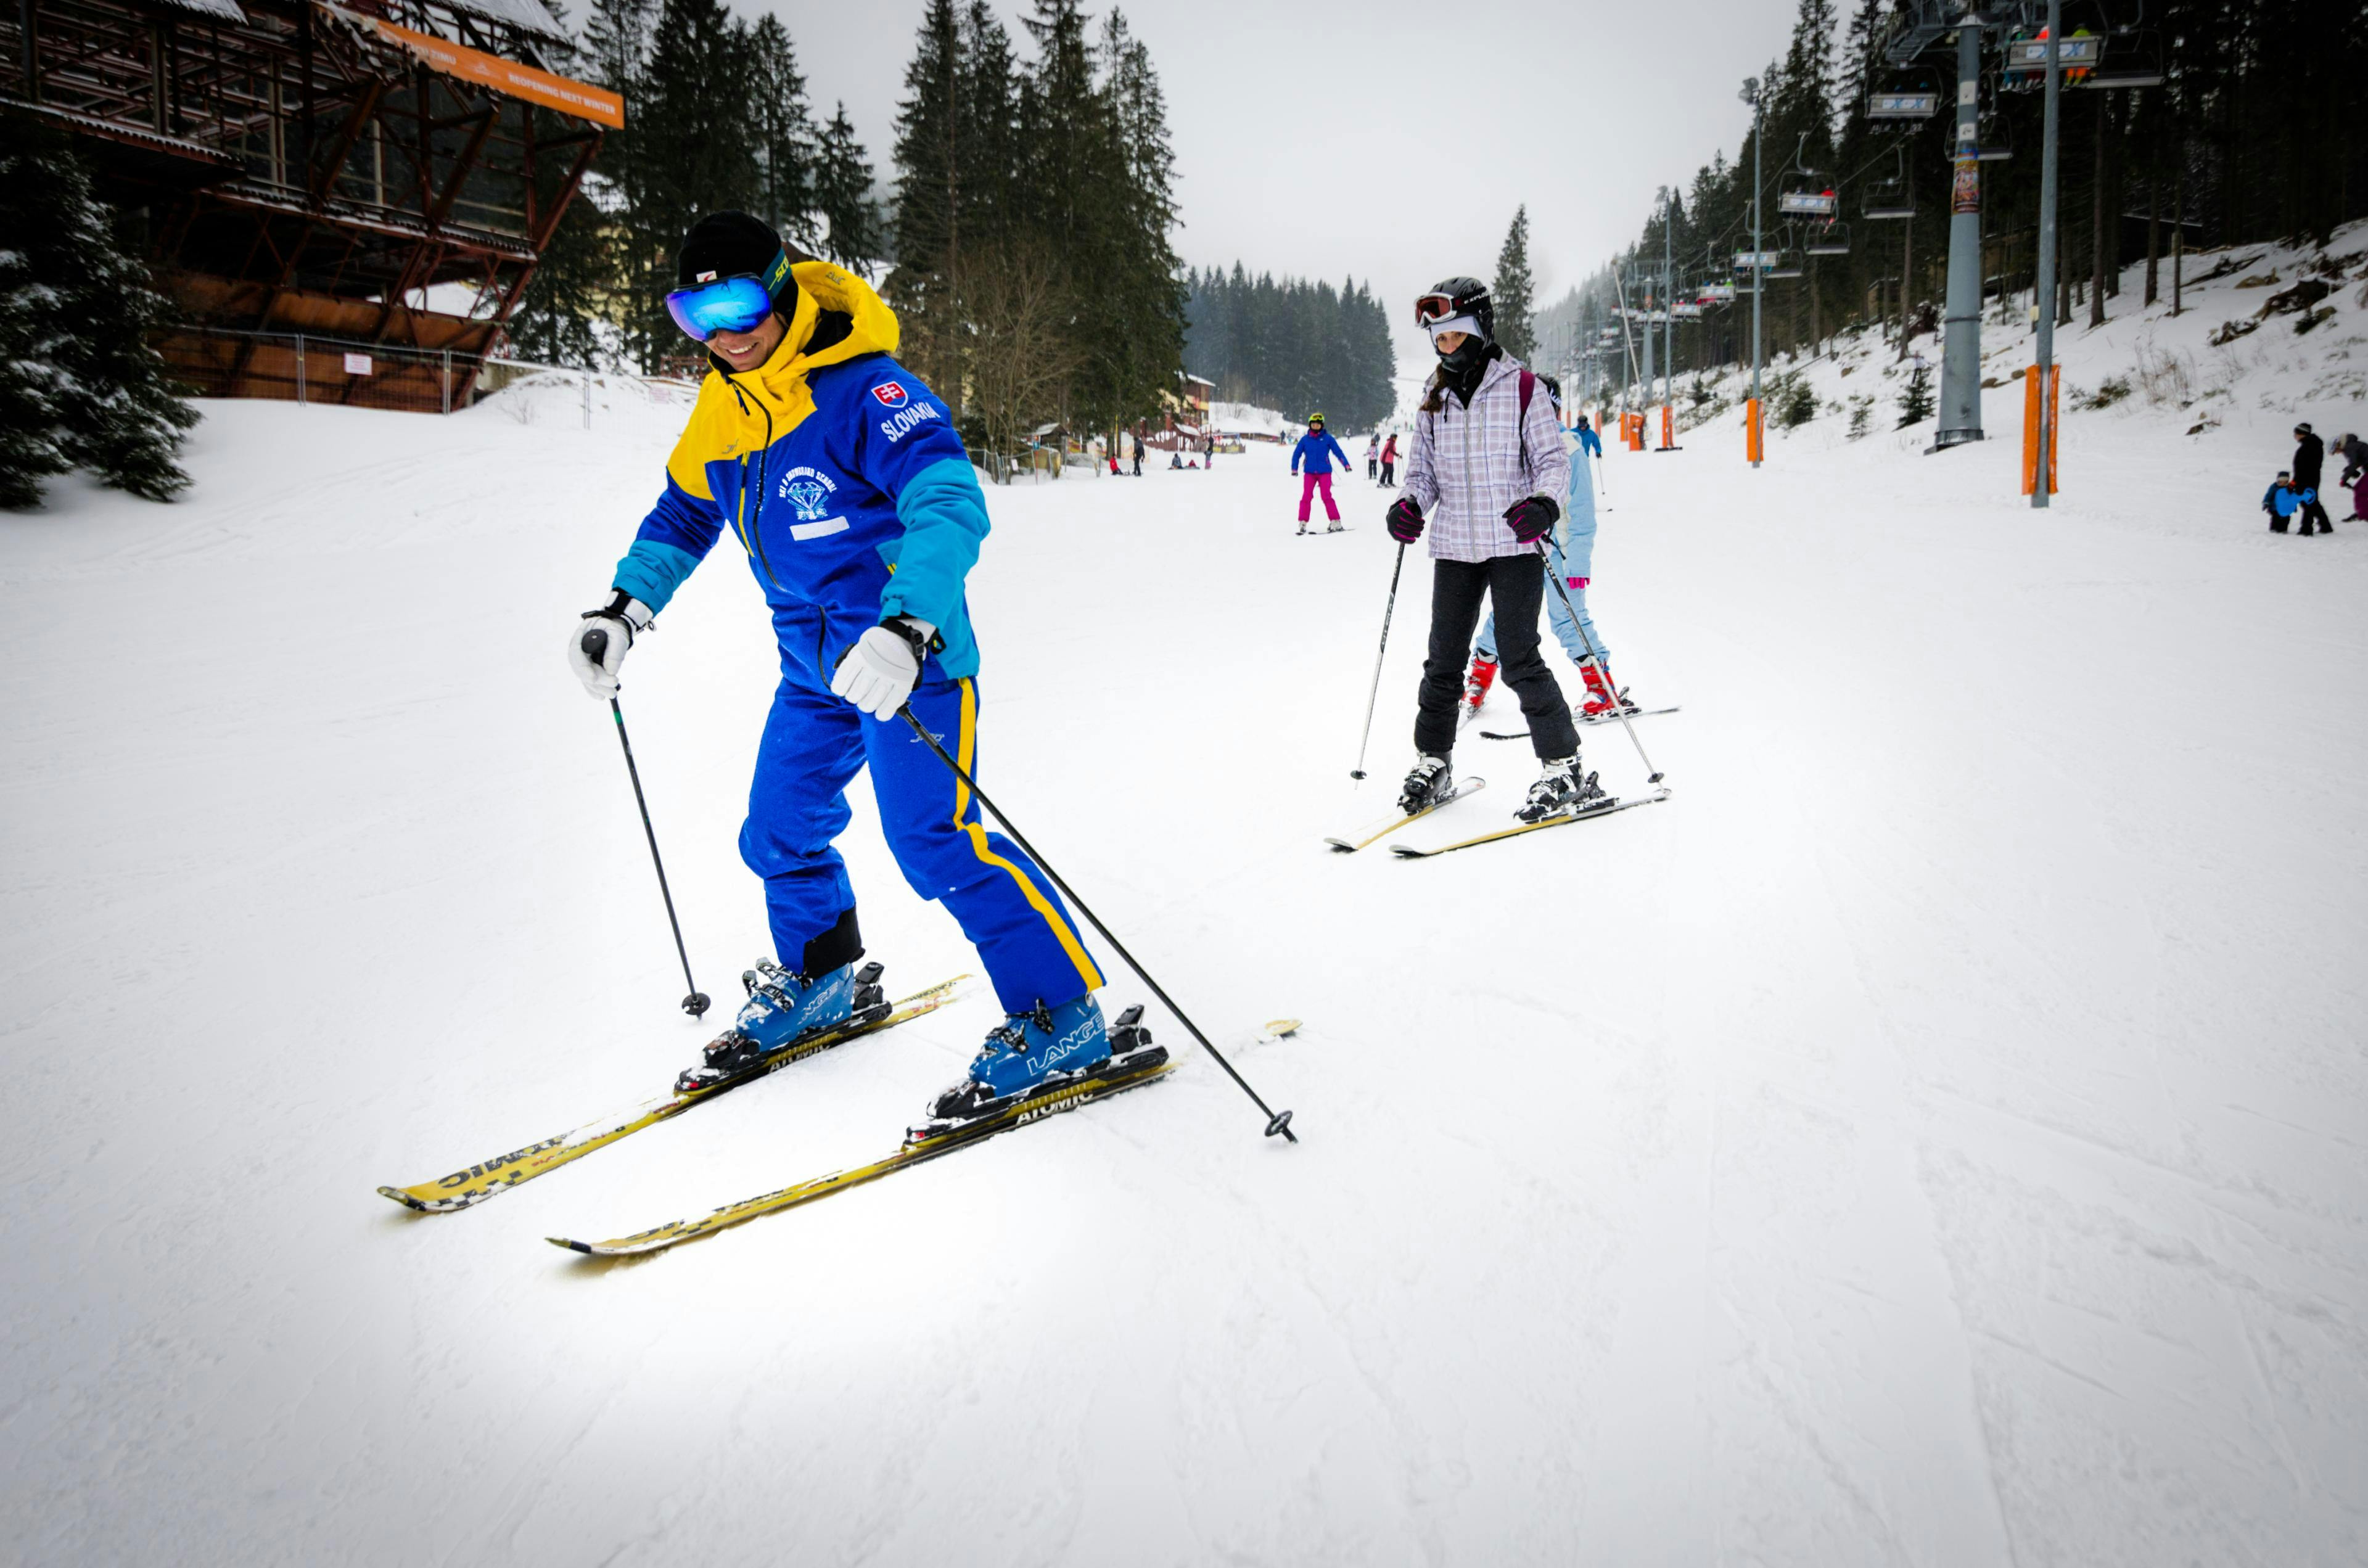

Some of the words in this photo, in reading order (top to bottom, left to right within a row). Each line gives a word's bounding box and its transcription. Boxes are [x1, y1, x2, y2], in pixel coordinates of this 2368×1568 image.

[508, 72, 559, 97] REOPENING
[560, 89, 583, 105] NEXT
[584, 98, 615, 115] WINTER
[881, 401, 941, 443] SLOVAKIA
[1026, 1011, 1105, 1077] LANGE
[1016, 1092, 1093, 1125] ATOMIC
